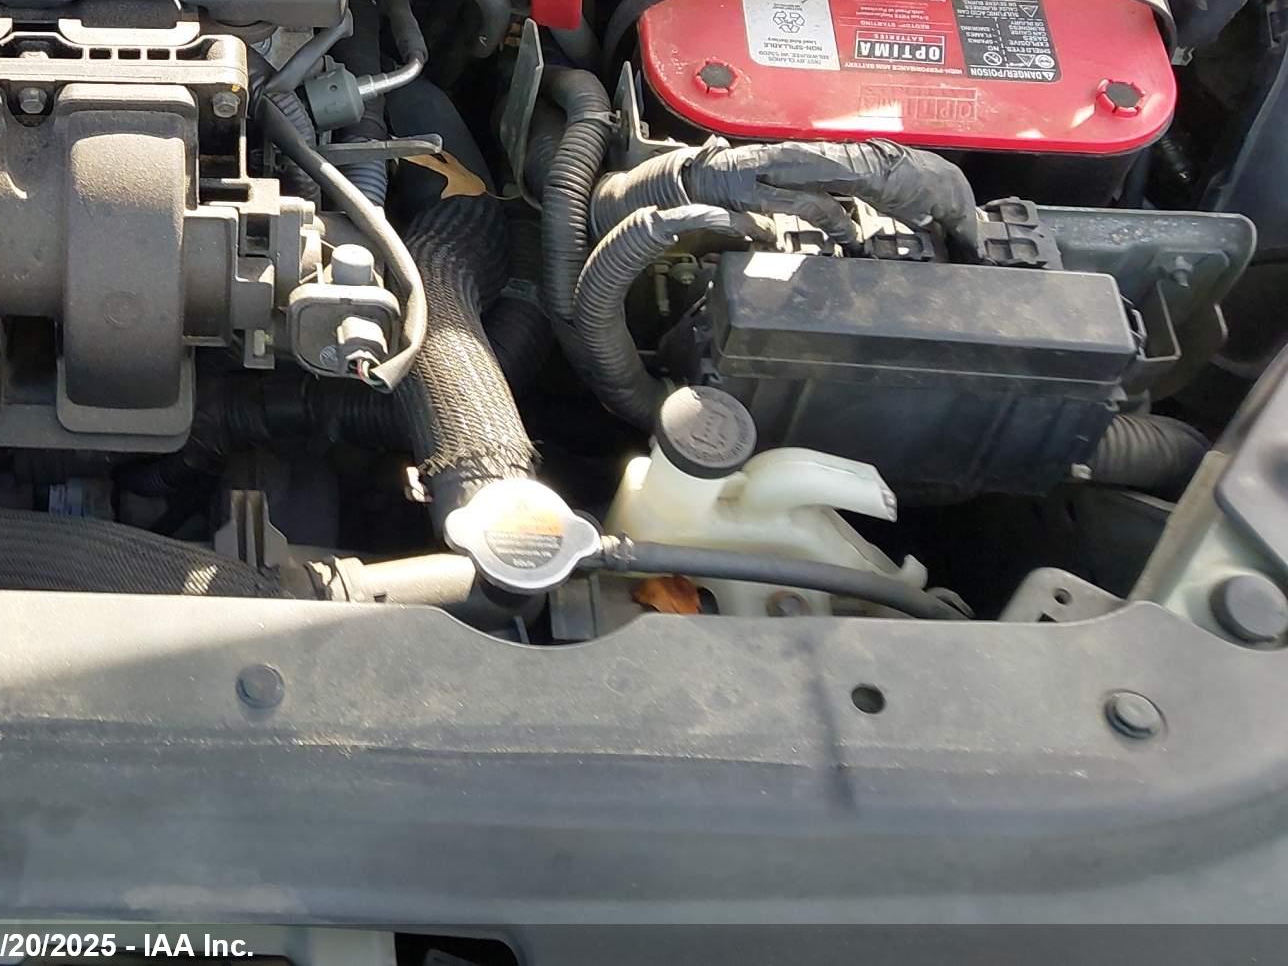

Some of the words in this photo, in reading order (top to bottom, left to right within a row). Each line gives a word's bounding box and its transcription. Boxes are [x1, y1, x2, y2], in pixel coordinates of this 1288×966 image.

[873, 33, 924, 42] BATTERIES
[764, 42, 822, 52] NON-SPILLABLE
[859, 41, 940, 61] OPTIMA
[970, 68, 1043, 80] DANGER/POISON
